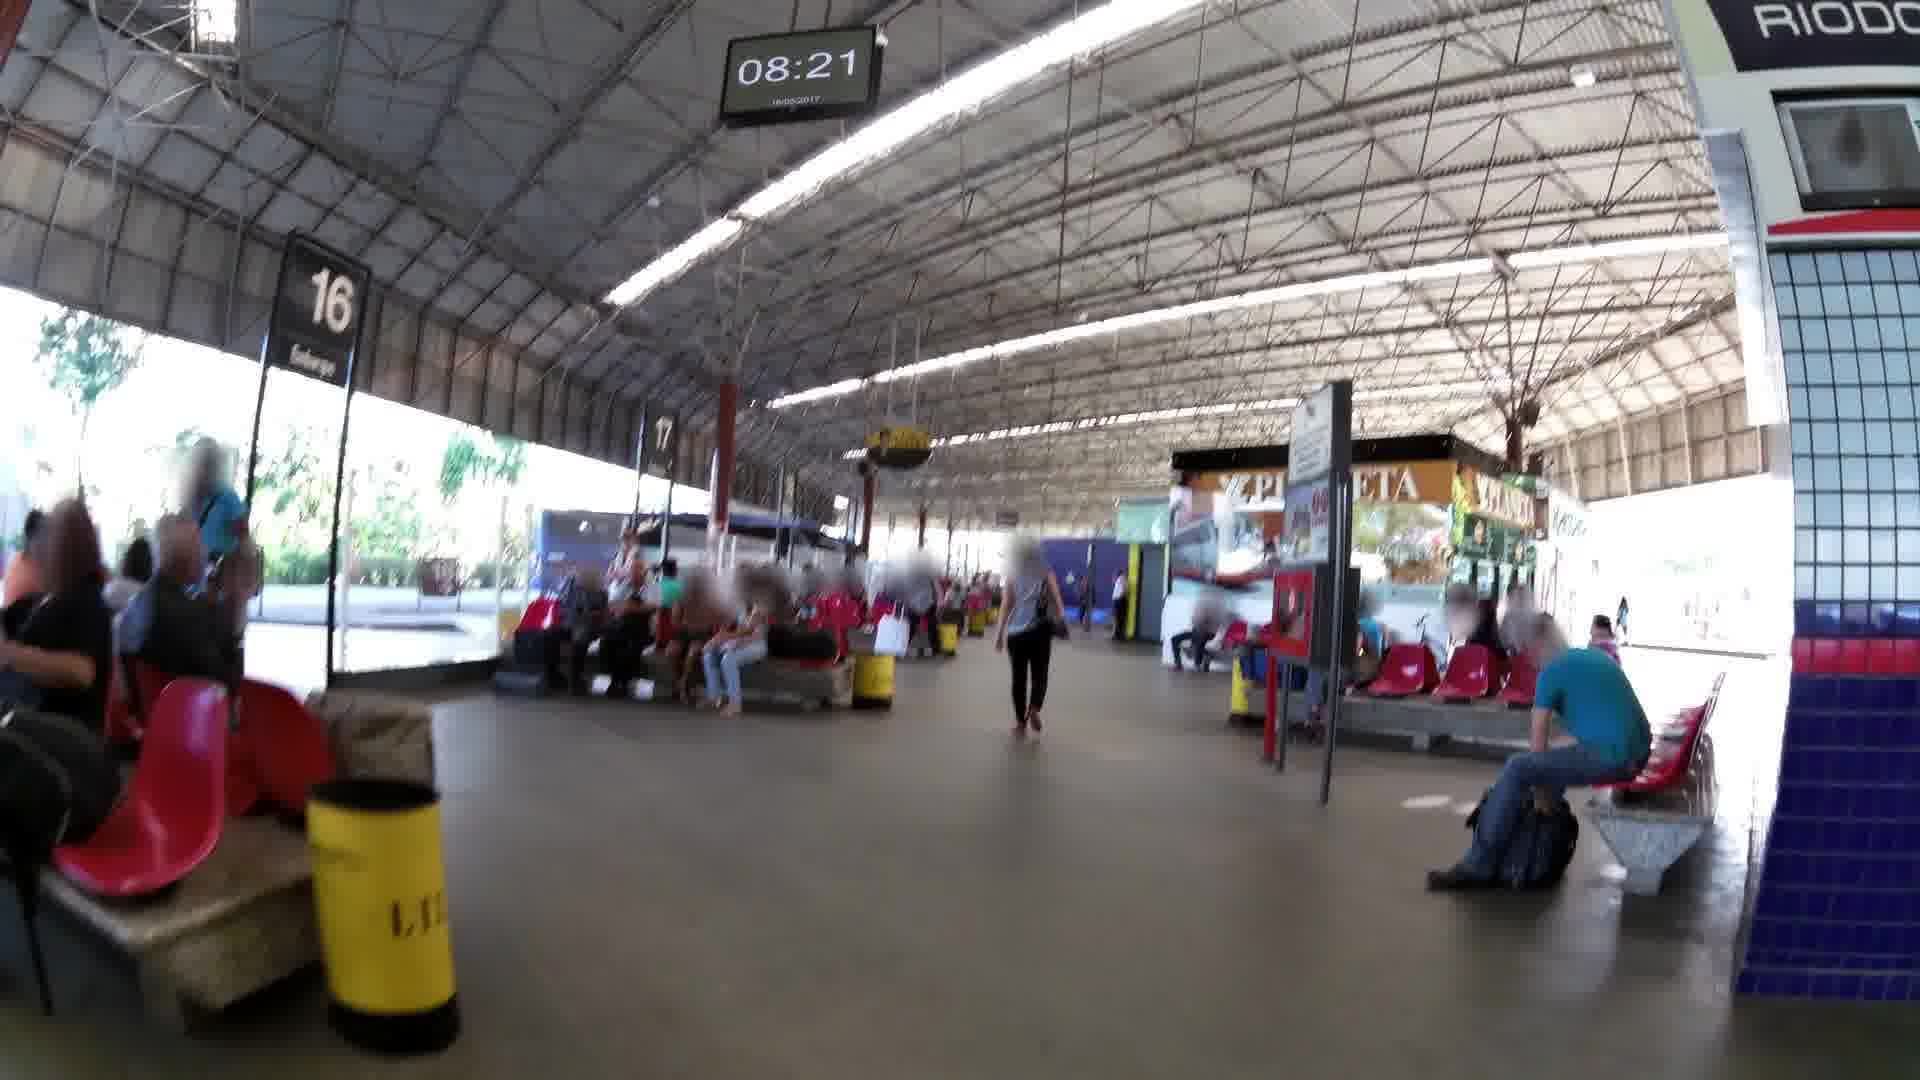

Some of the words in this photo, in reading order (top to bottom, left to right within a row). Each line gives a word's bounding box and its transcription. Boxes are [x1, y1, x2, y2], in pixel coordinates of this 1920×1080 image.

[738, 48, 856, 85] 08:21
[312, 267, 355, 334] 16
[656, 416, 672, 452] 17
